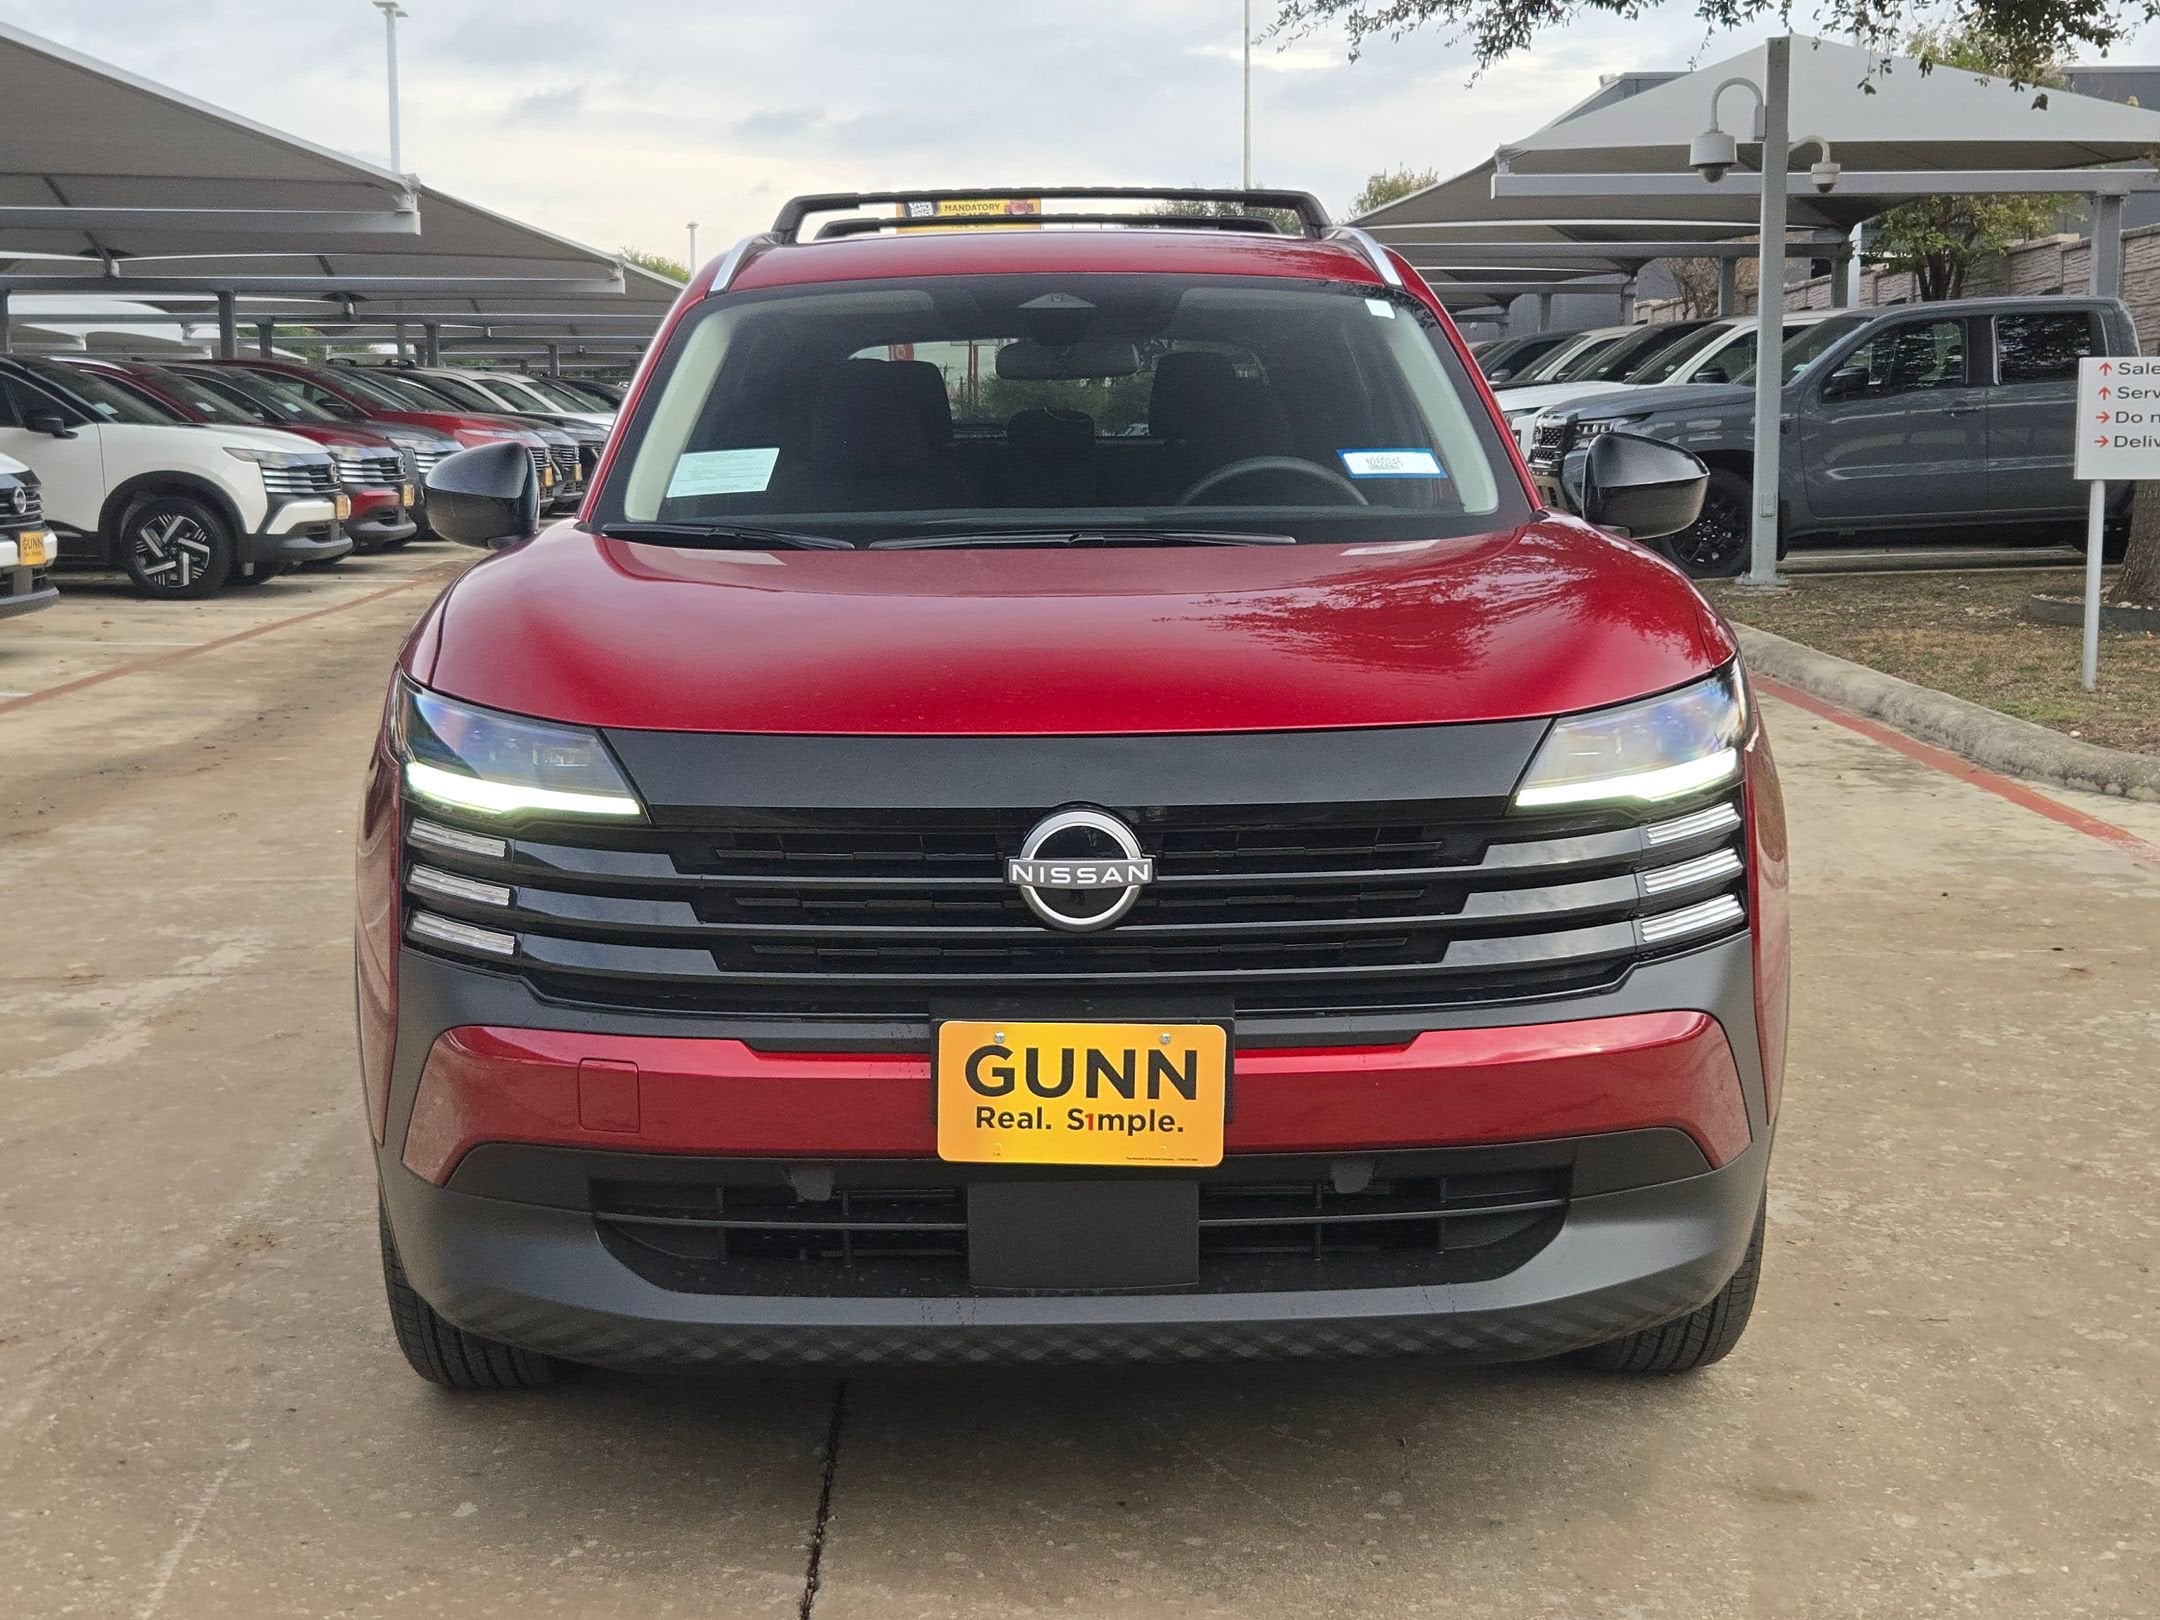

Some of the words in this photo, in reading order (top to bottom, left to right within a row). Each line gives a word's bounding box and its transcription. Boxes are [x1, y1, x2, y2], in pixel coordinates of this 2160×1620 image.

[944, 203, 1000, 212] MANDATORY
[2118, 362, 2160, 375] Sale
[2115, 411, 2143, 423] Do
[22, 535, 44, 550] GUNN
[1012, 864, 1148, 884] NISSAN
[964, 1044, 1198, 1100] GUNN
[976, 1106, 1052, 1130] Real.
[1067, 1108, 1184, 1136] S1mple.
